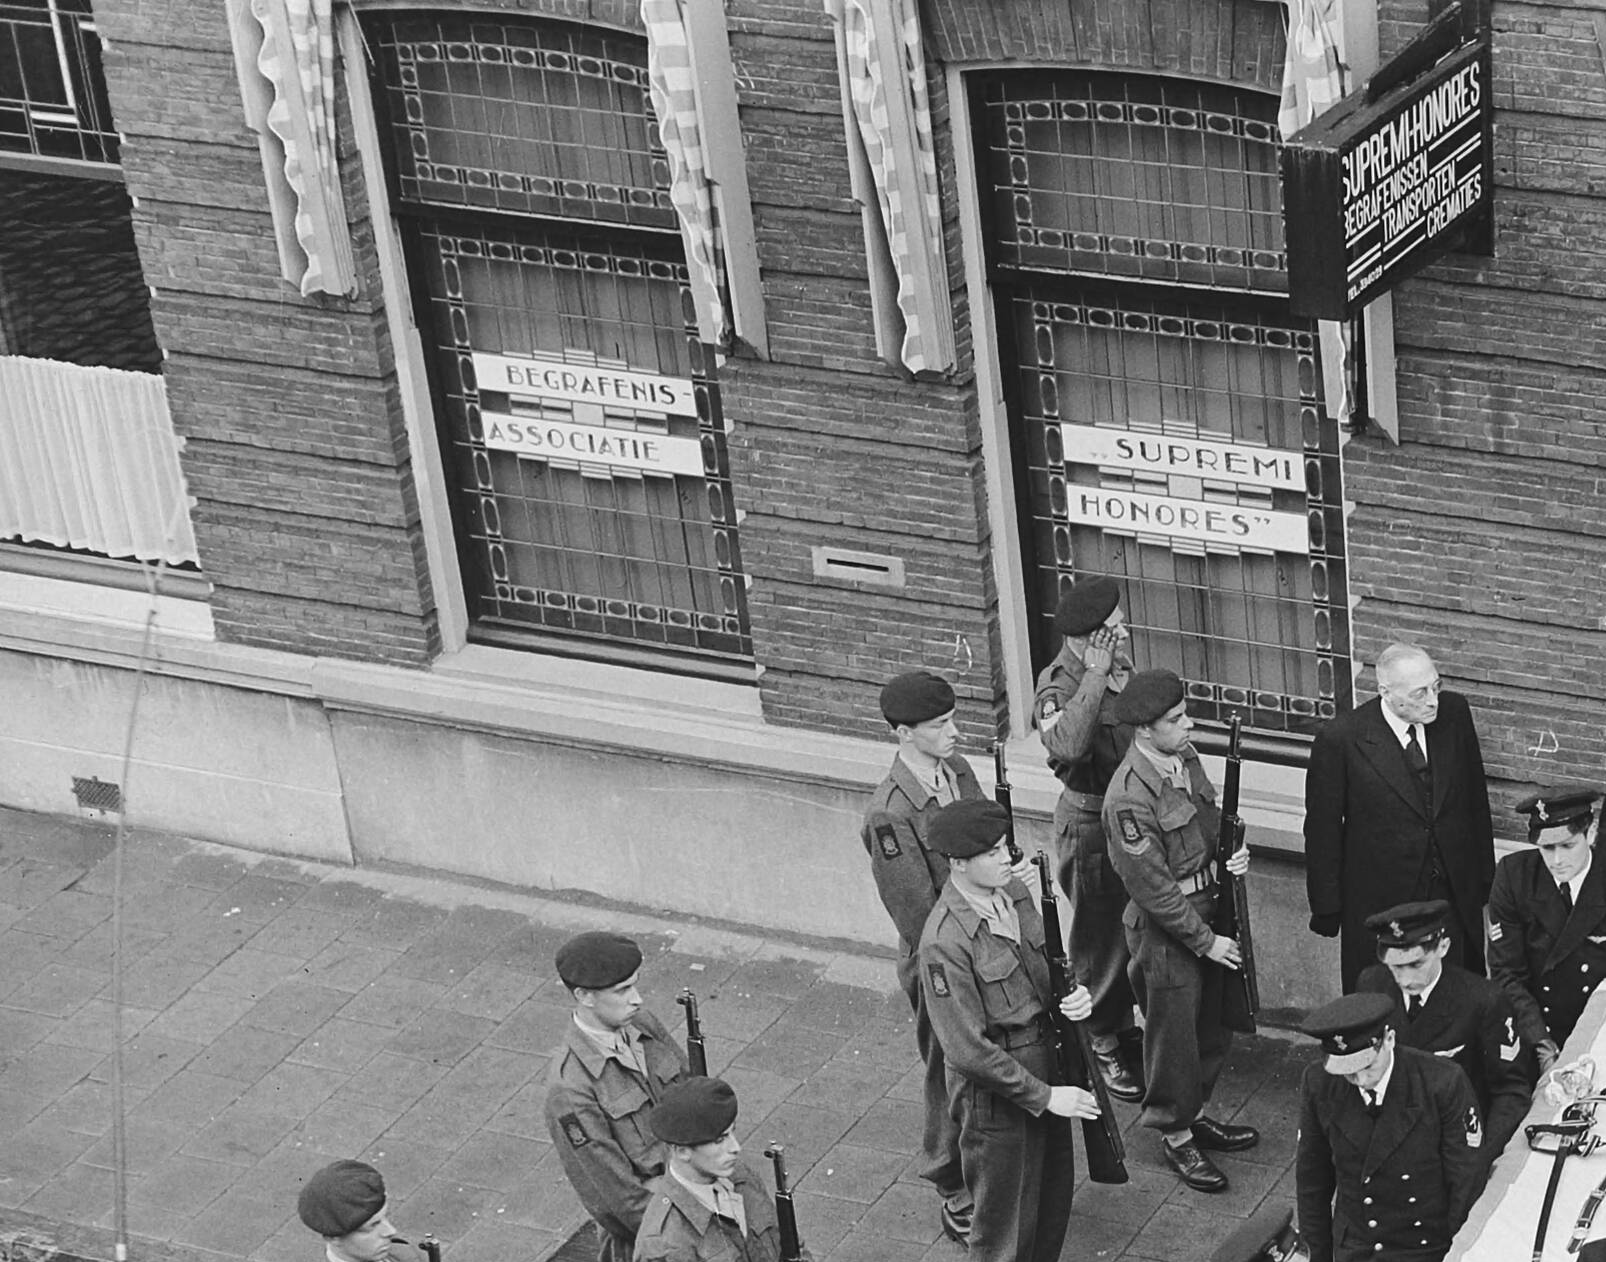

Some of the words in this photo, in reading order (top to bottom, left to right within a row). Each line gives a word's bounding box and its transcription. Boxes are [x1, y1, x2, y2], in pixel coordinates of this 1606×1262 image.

[1381, 161, 1456, 243] TRANSPORTEN
[1426, 173, 1482, 239] CREMATIES
[489, 421, 661, 463] ASSOCIATIE
